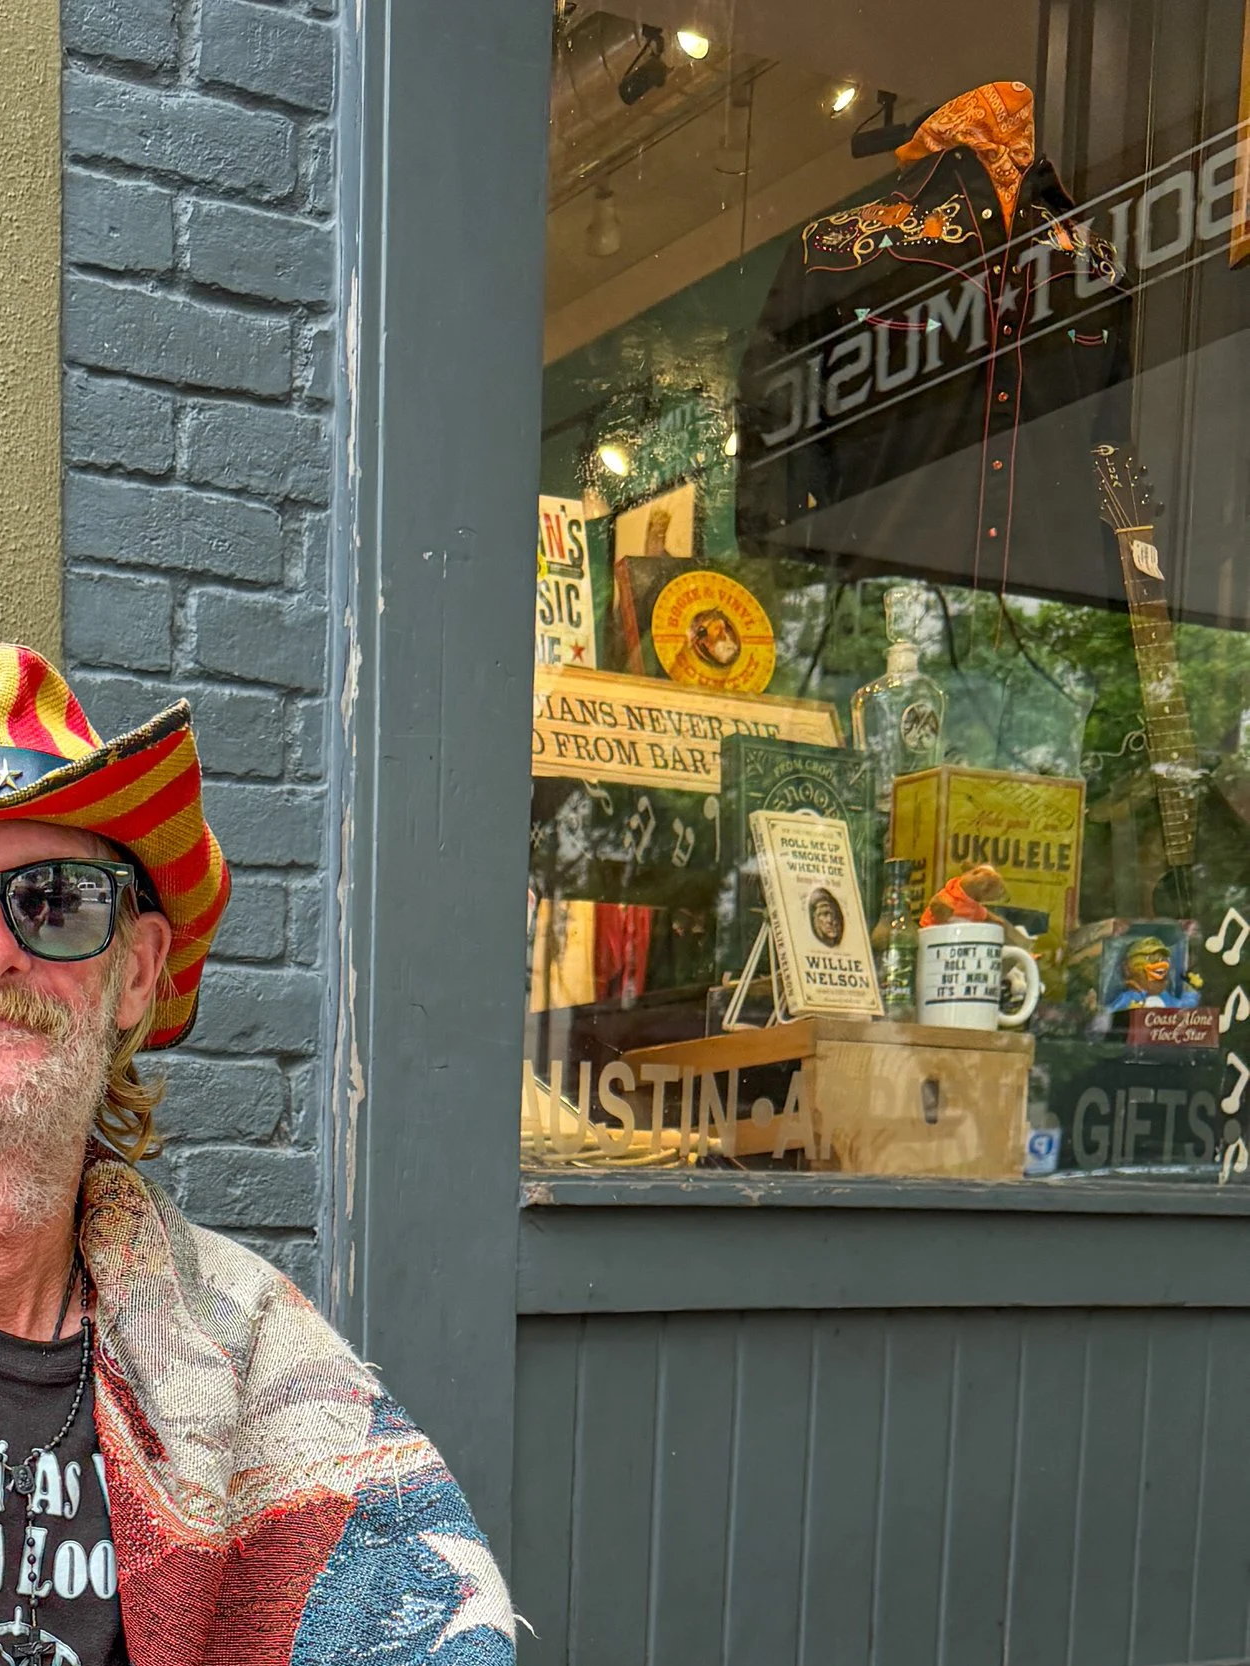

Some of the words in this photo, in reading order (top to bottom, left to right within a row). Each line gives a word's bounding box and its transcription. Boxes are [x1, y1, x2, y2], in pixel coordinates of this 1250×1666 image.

[622, 704, 725, 740] NEVER
[549, 731, 643, 768] FROM
[648, 742, 712, 776] BAR
[781, 837, 808, 849] ROLL
[810, 840, 825, 852] ME
[827, 842, 841, 853] UP
[951, 832, 1072, 872] UKULELE
[791, 850, 829, 863] SMOKE
[830, 854, 845, 866] ME
[786, 862, 820, 874] WHEN
[828, 865, 845, 877] DIE
[805, 955, 863, 973] WILLIE
[805, 971, 870, 989] NELSON
[1144, 1011, 1178, 1028] Coast
[1176, 1010, 1213, 1026] Alone
[1183, 1028, 1207, 1042] Star
[1072, 1087, 1218, 1170] GIFTS
[29, 1447, 82, 1520] AS
